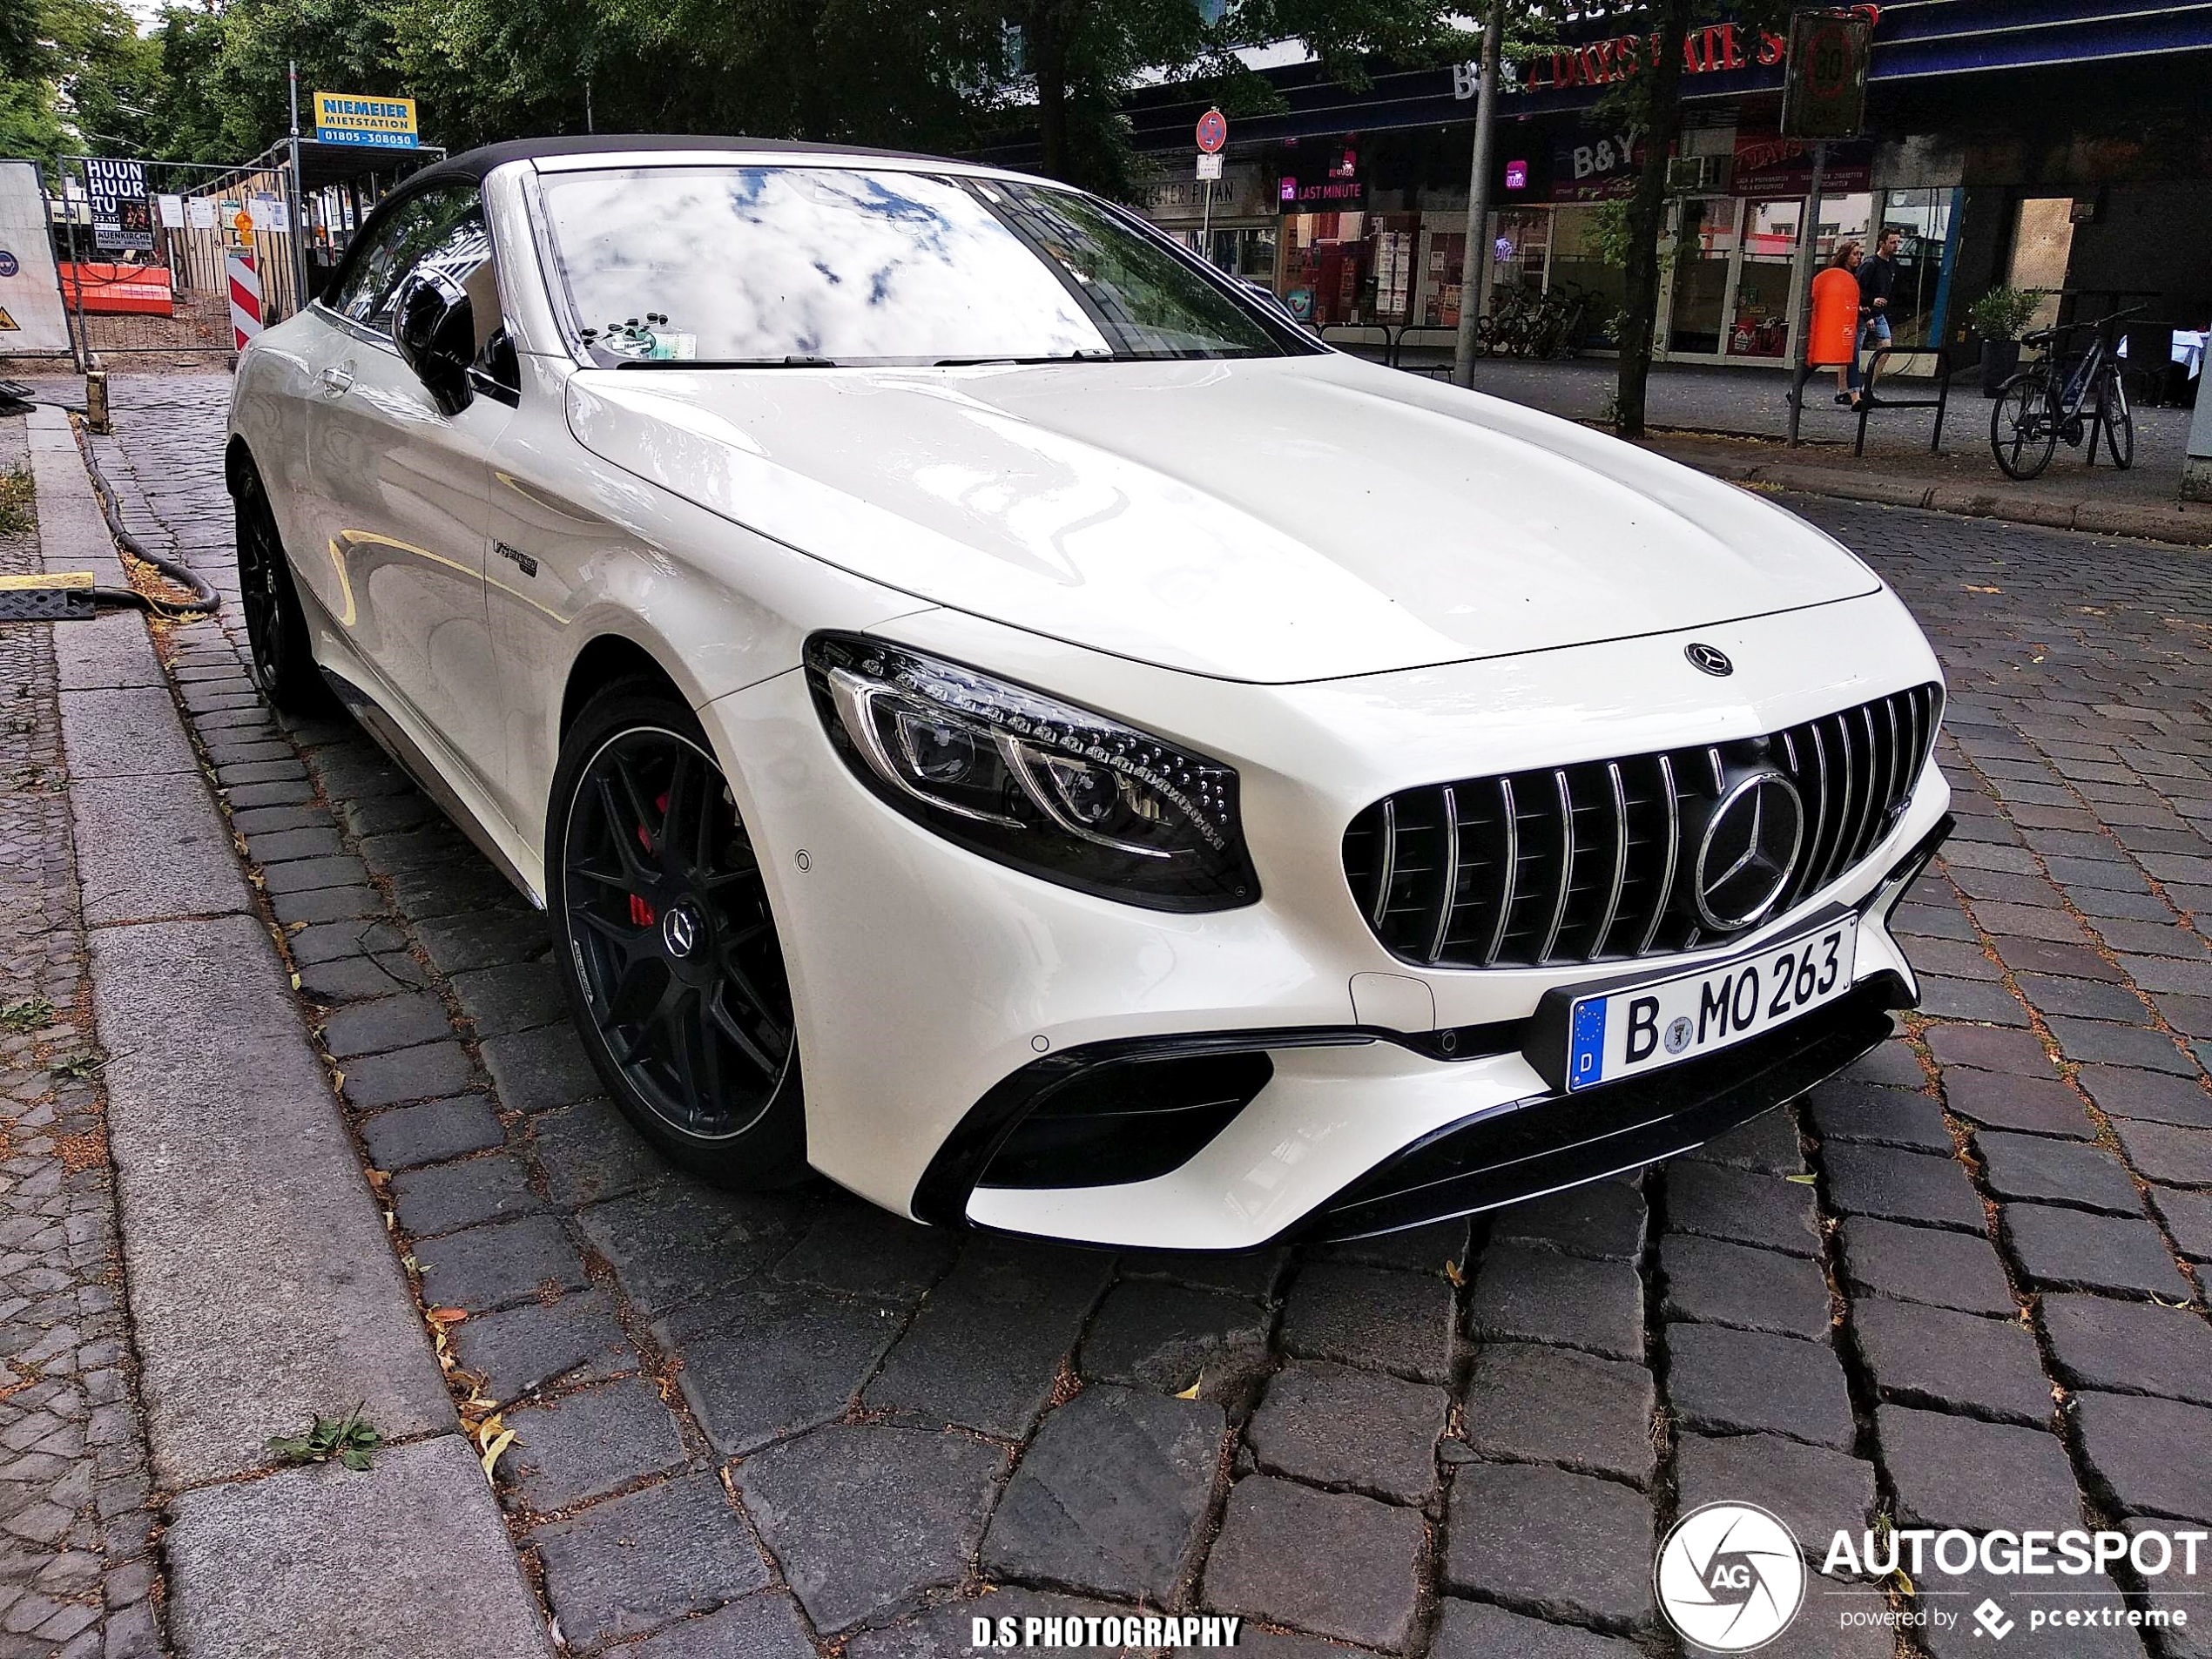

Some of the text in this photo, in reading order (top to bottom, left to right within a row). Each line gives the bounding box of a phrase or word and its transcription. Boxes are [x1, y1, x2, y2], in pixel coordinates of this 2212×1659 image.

[323, 99, 408, 118] NIEMEIER
[325, 116, 408, 129] MIETSTATION
[1574, 131, 1642, 179] B&Y
[87, 160, 143, 180] HUUN
[90, 178, 145, 198] HUUR
[1298, 185, 1322, 201] LAST
[1323, 182, 1362, 199] MINUTE
[91, 195, 117, 213] TU
[98, 232, 151, 240] AUENKIRCHE
[1625, 995, 1660, 1064] B
[1697, 966, 1760, 1044] MO
[1768, 931, 1841, 1020] 263
[1580, 1053, 1593, 1073] D
